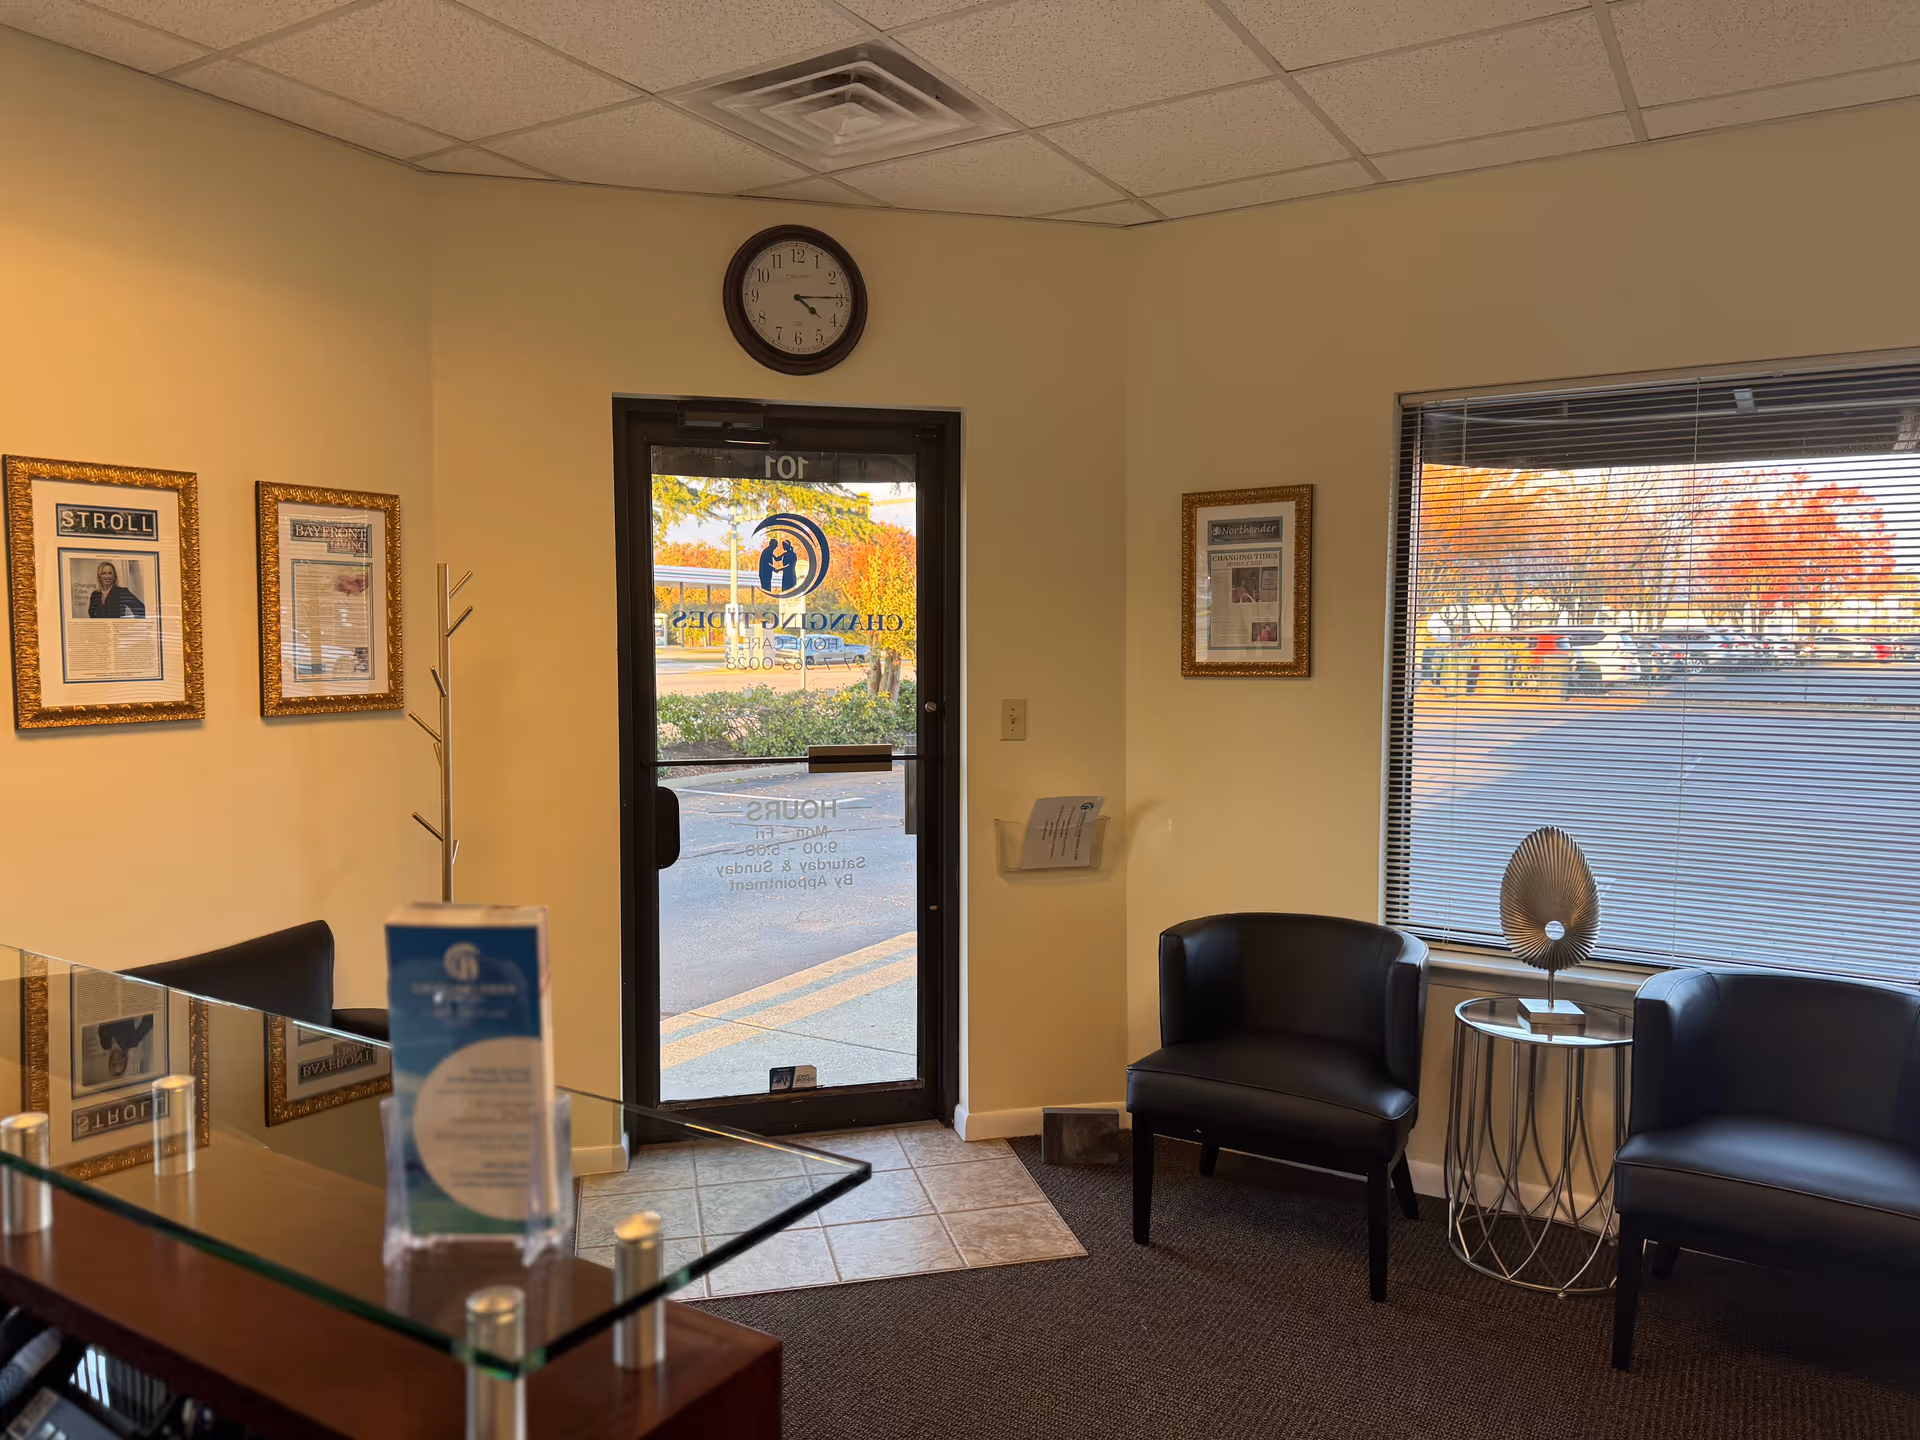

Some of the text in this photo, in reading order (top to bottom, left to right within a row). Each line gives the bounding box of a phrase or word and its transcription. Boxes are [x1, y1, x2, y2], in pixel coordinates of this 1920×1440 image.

[772, 254, 782, 268] 11
[790, 249, 805, 264] 12
[814, 254, 820, 269] 1
[756, 268, 770, 283] 10
[828, 270, 837, 285] 2
[752, 289, 759, 303] 9
[835, 293, 843, 308] 3
[758, 310, 766, 325] 8
[830, 313, 837, 327] 4
[775, 326, 783, 341] 7
[795, 331, 802, 345] 6
[816, 329, 823, 343] 5
[61, 510, 153, 532] STROLL
[295, 524, 367, 541] BAYFRONT
[1221, 523, 1277, 535] Northender
[1212, 552, 1278, 562] CHANGING TIDES
